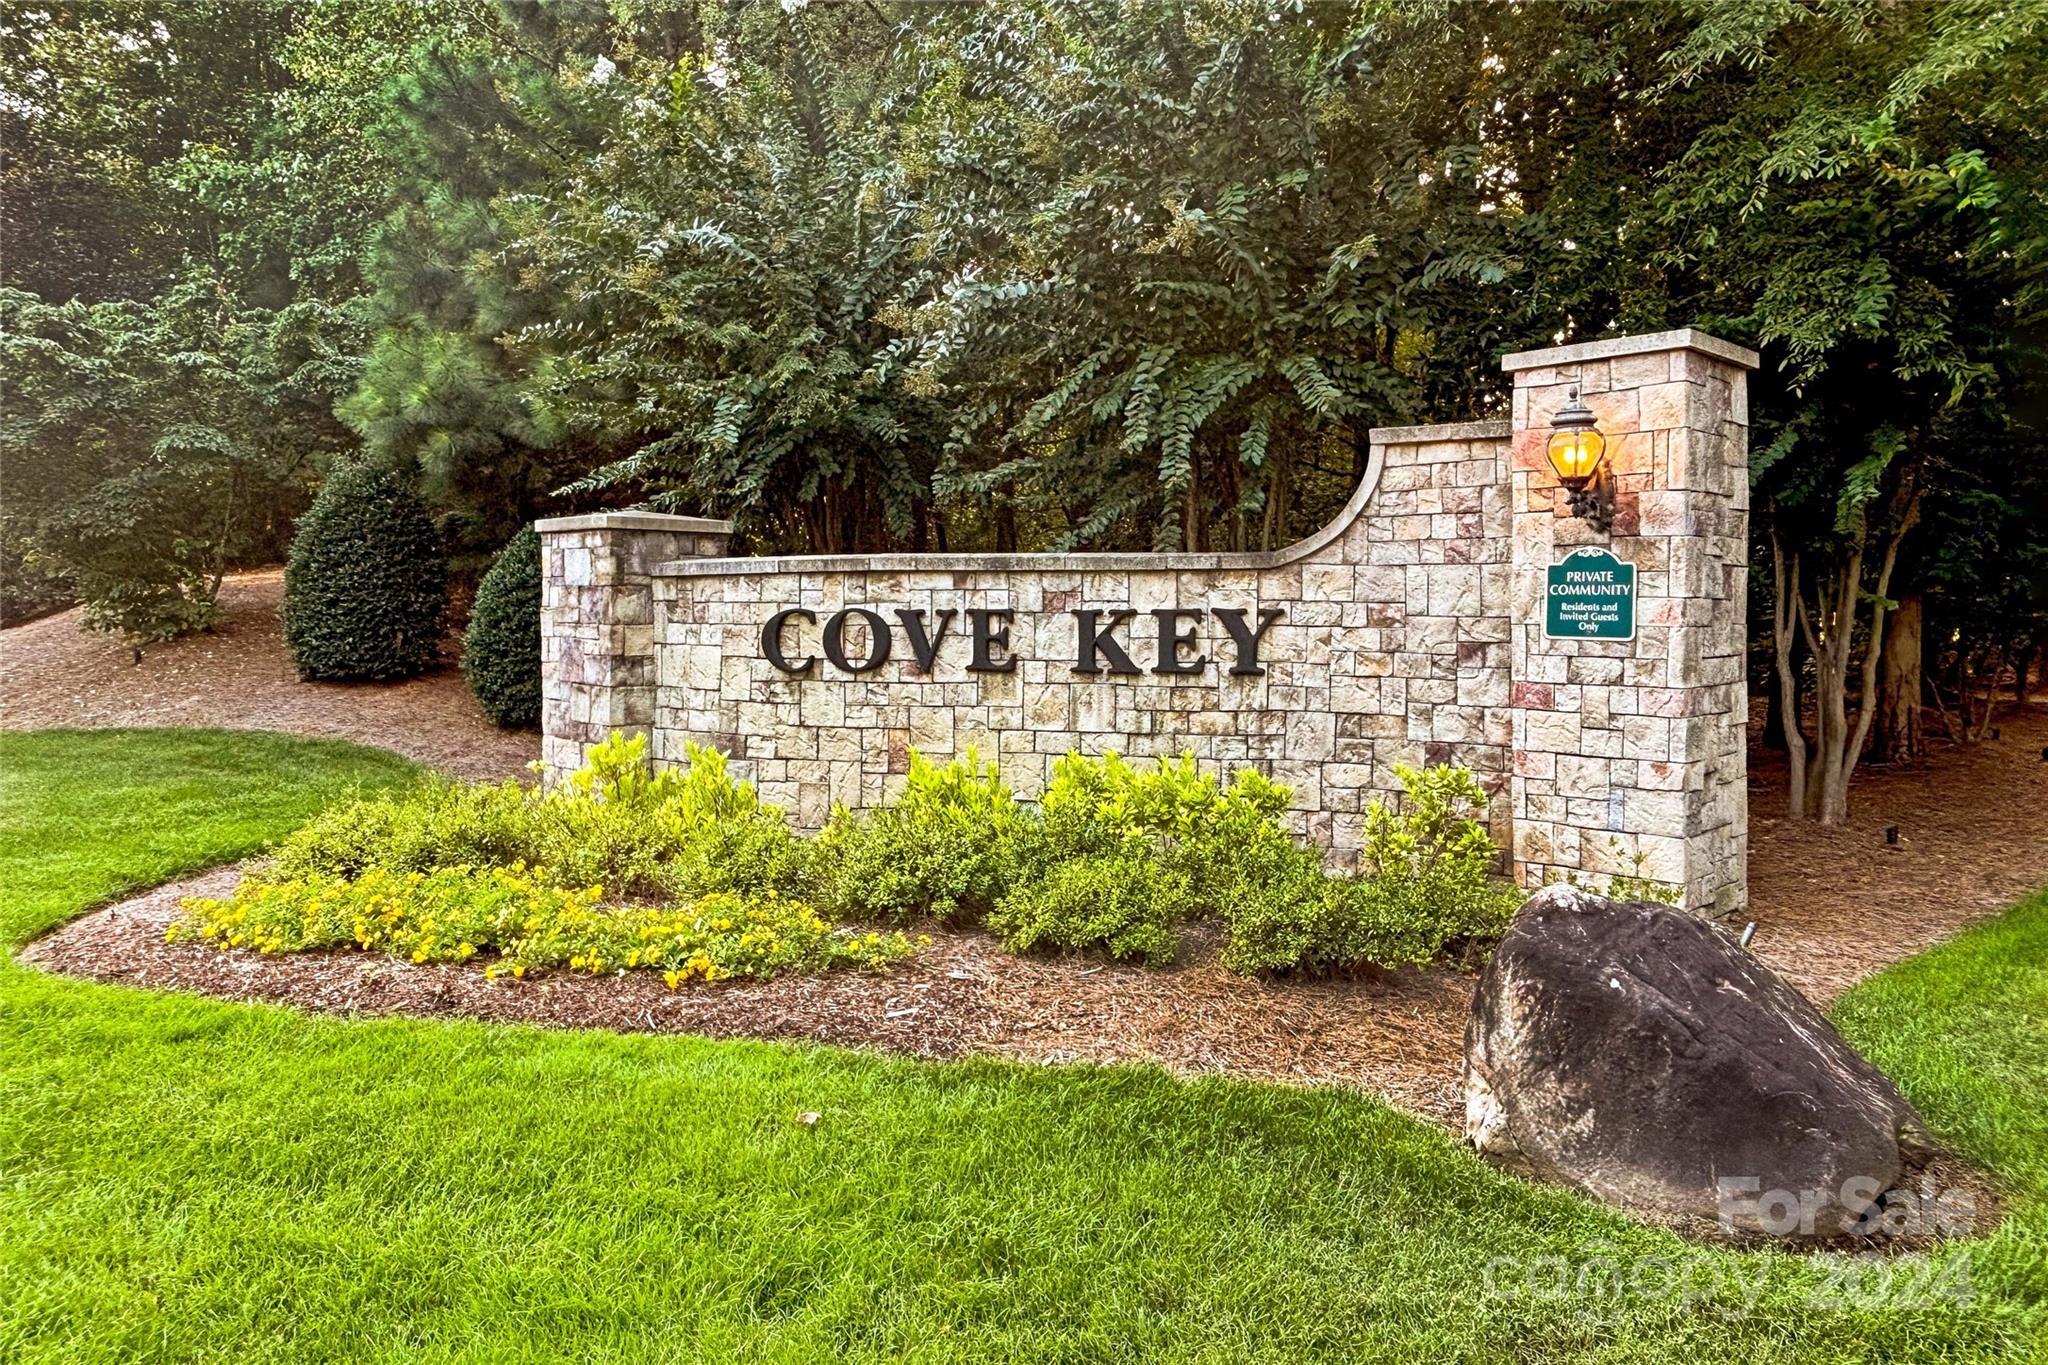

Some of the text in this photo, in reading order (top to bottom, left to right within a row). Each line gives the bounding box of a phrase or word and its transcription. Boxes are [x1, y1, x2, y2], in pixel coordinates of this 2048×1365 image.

[1566, 571, 1614, 582] PRIVATE
[1550, 584, 1630, 595] COMMUNITY
[1561, 602, 1618, 611] Residents and
[1559, 612, 1618, 621] Invited Guests
[1578, 622, 1599, 632] Only
[761, 607, 1285, 677] COVE KEY
